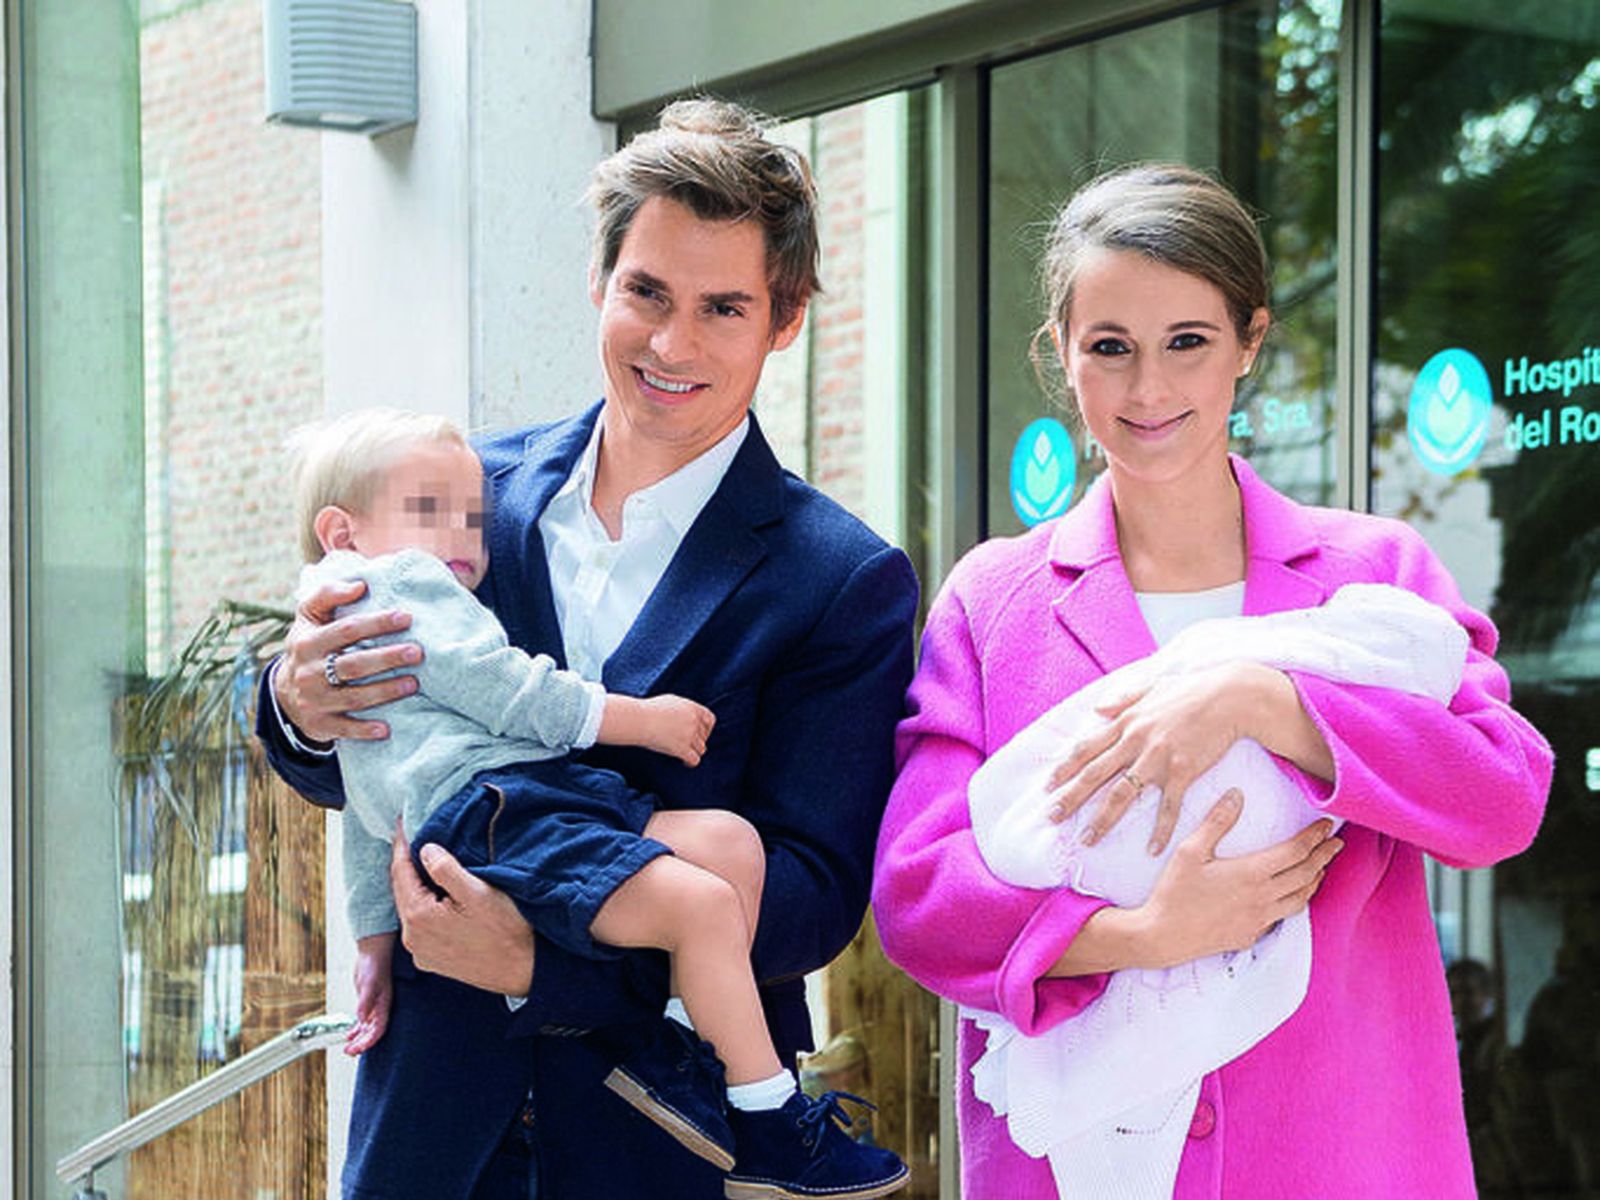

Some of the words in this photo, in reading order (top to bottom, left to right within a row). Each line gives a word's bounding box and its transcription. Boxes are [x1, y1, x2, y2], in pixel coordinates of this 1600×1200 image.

[1263, 398, 1312, 433] Sra.
[1504, 408, 1551, 450] del
[1560, 405, 1600, 445] Ro
